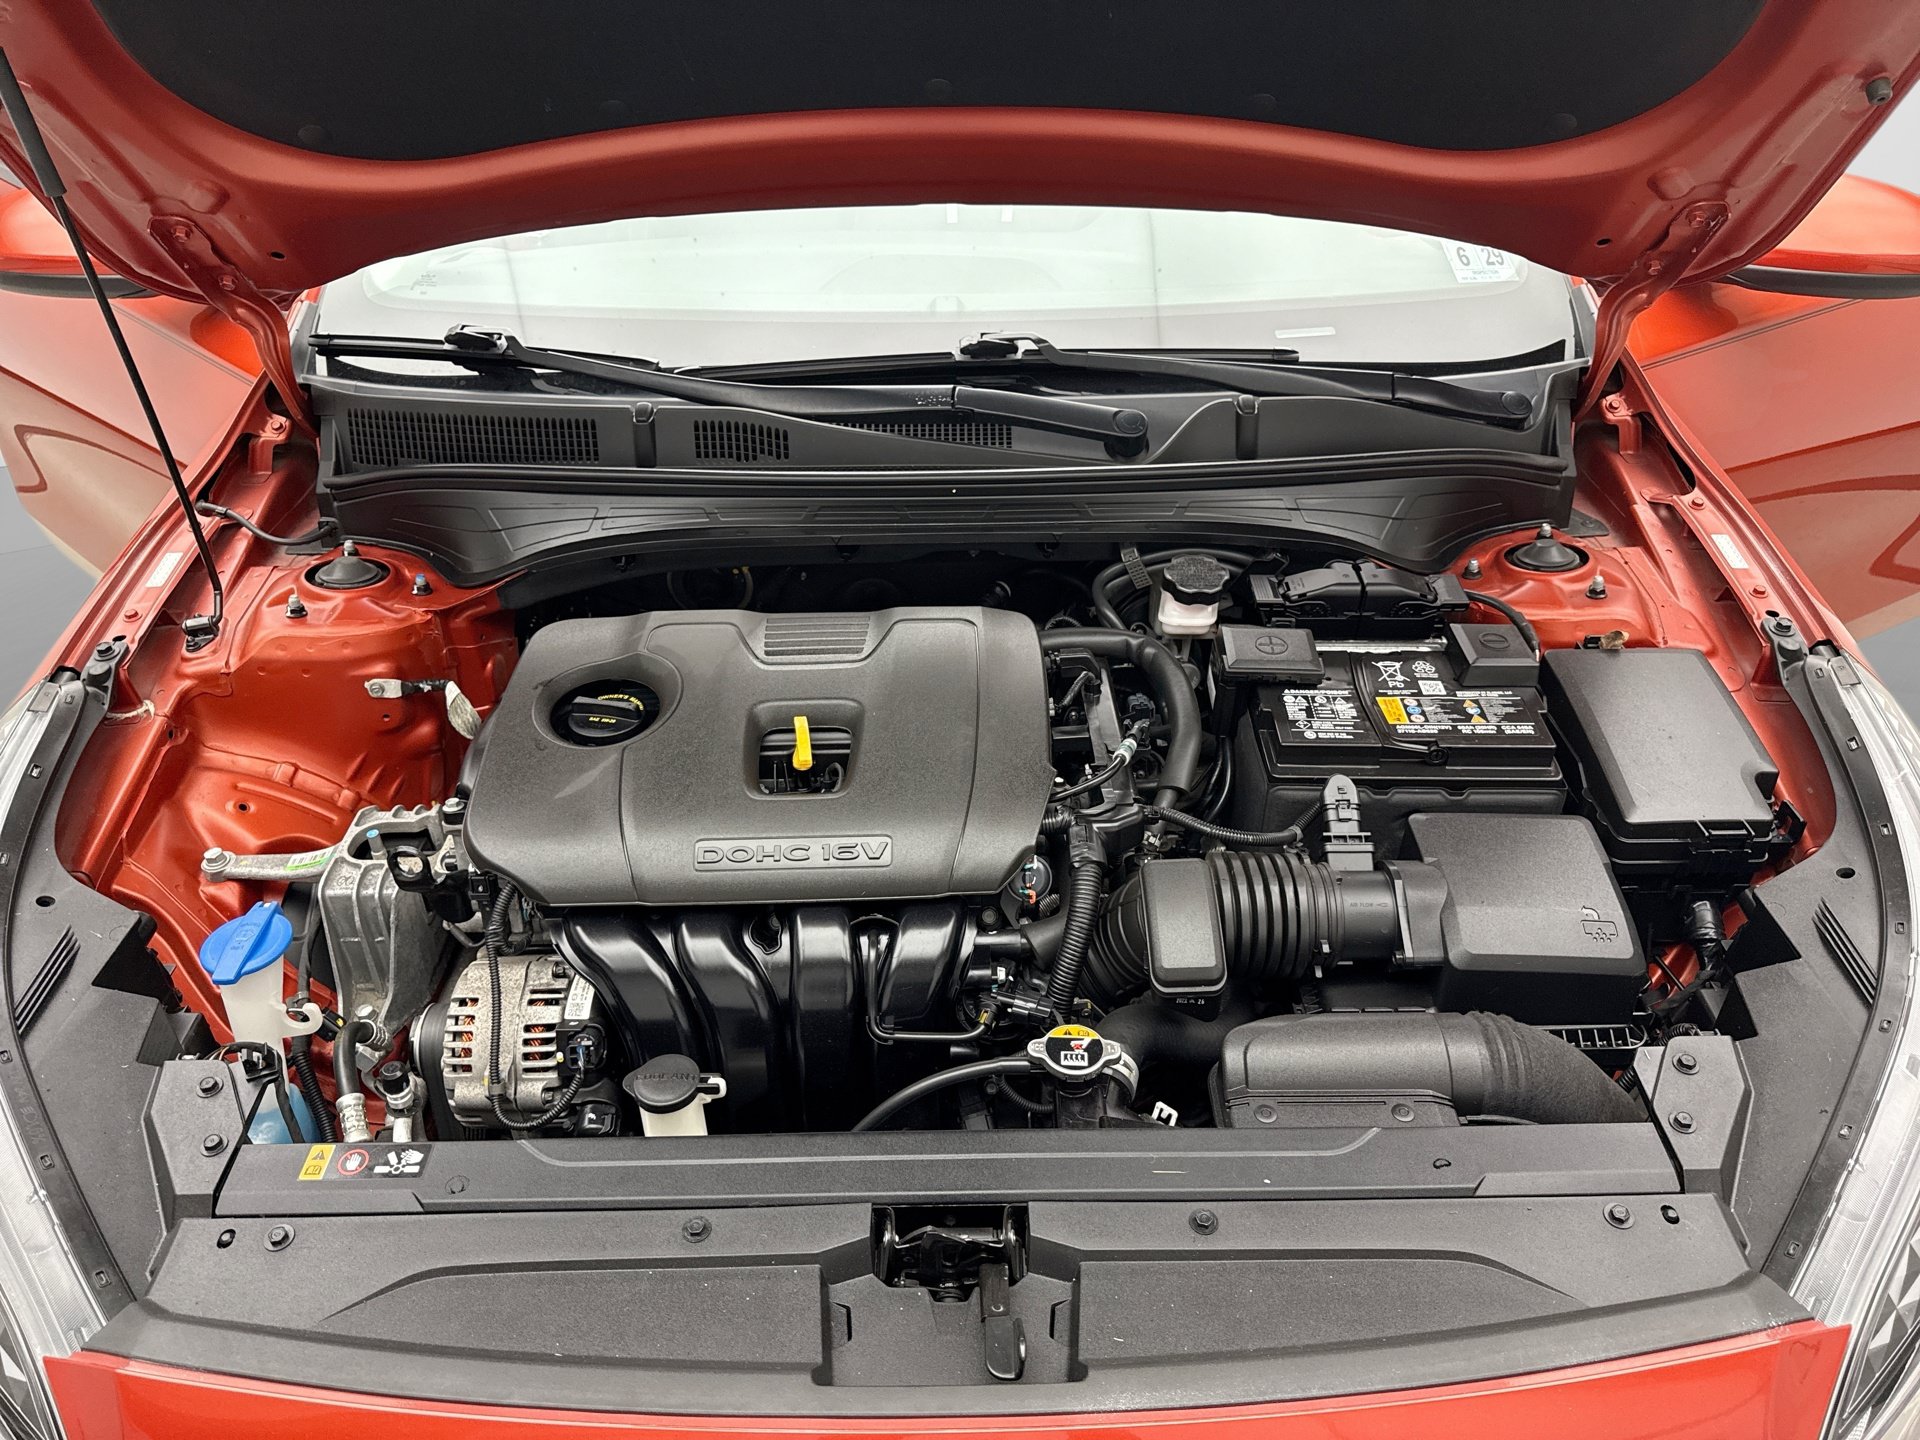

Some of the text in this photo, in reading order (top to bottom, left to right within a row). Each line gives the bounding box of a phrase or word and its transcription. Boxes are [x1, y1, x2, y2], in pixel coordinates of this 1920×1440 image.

[1456, 246, 1505, 267] 6 29
[597, 693, 629, 701] OWNER'S
[696, 842, 889, 864] DOHC 16V
